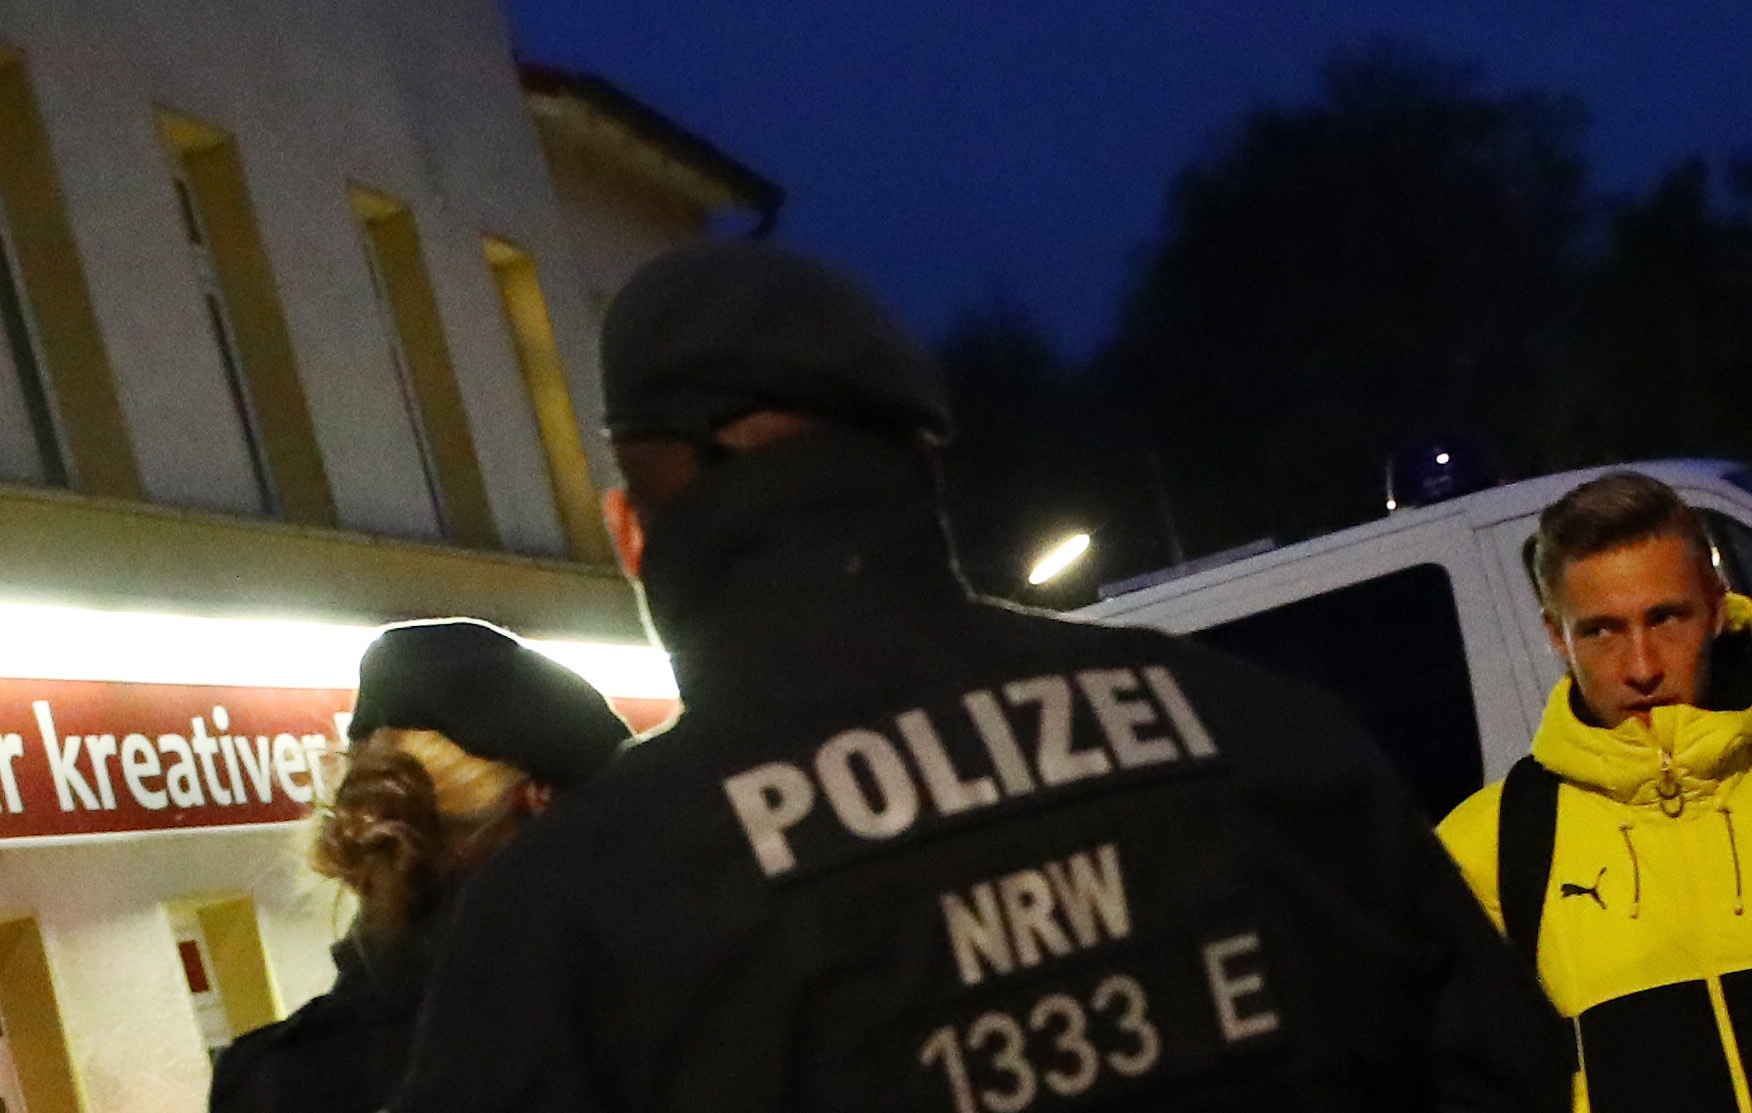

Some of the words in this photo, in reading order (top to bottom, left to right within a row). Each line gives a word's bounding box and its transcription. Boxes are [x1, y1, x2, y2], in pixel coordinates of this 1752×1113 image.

[0, 732, 25, 814] r
[32, 700, 328, 813] kreativer
[723, 664, 1219, 879] POLIZEI
[940, 844, 1131, 986] NRW
[1202, 932, 1282, 1043] E
